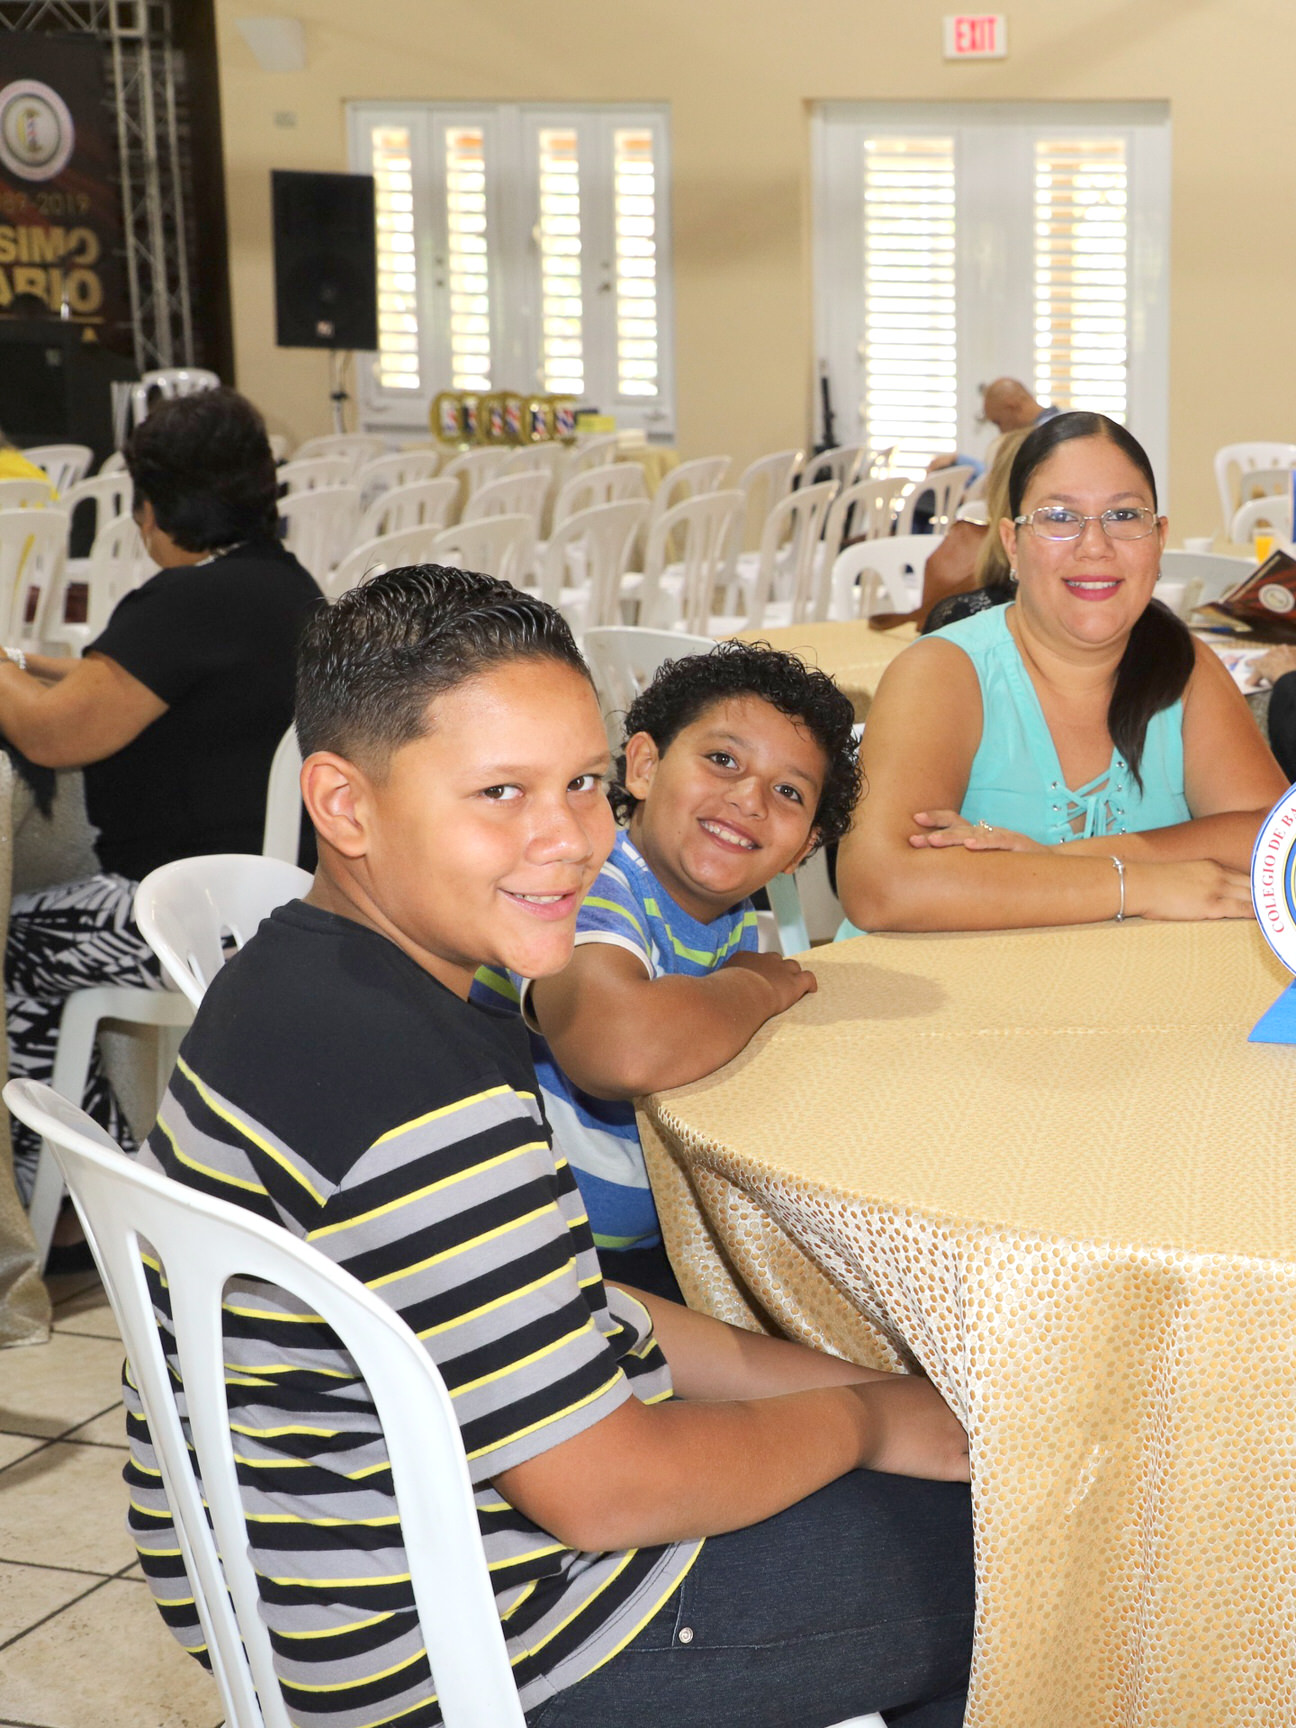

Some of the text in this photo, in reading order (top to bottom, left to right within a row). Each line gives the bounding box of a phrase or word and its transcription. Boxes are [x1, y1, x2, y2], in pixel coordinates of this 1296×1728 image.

[955, 17, 997, 53] EXIT
[1268, 828, 1286, 851] DE
[1262, 854, 1285, 934] COLEGIO
